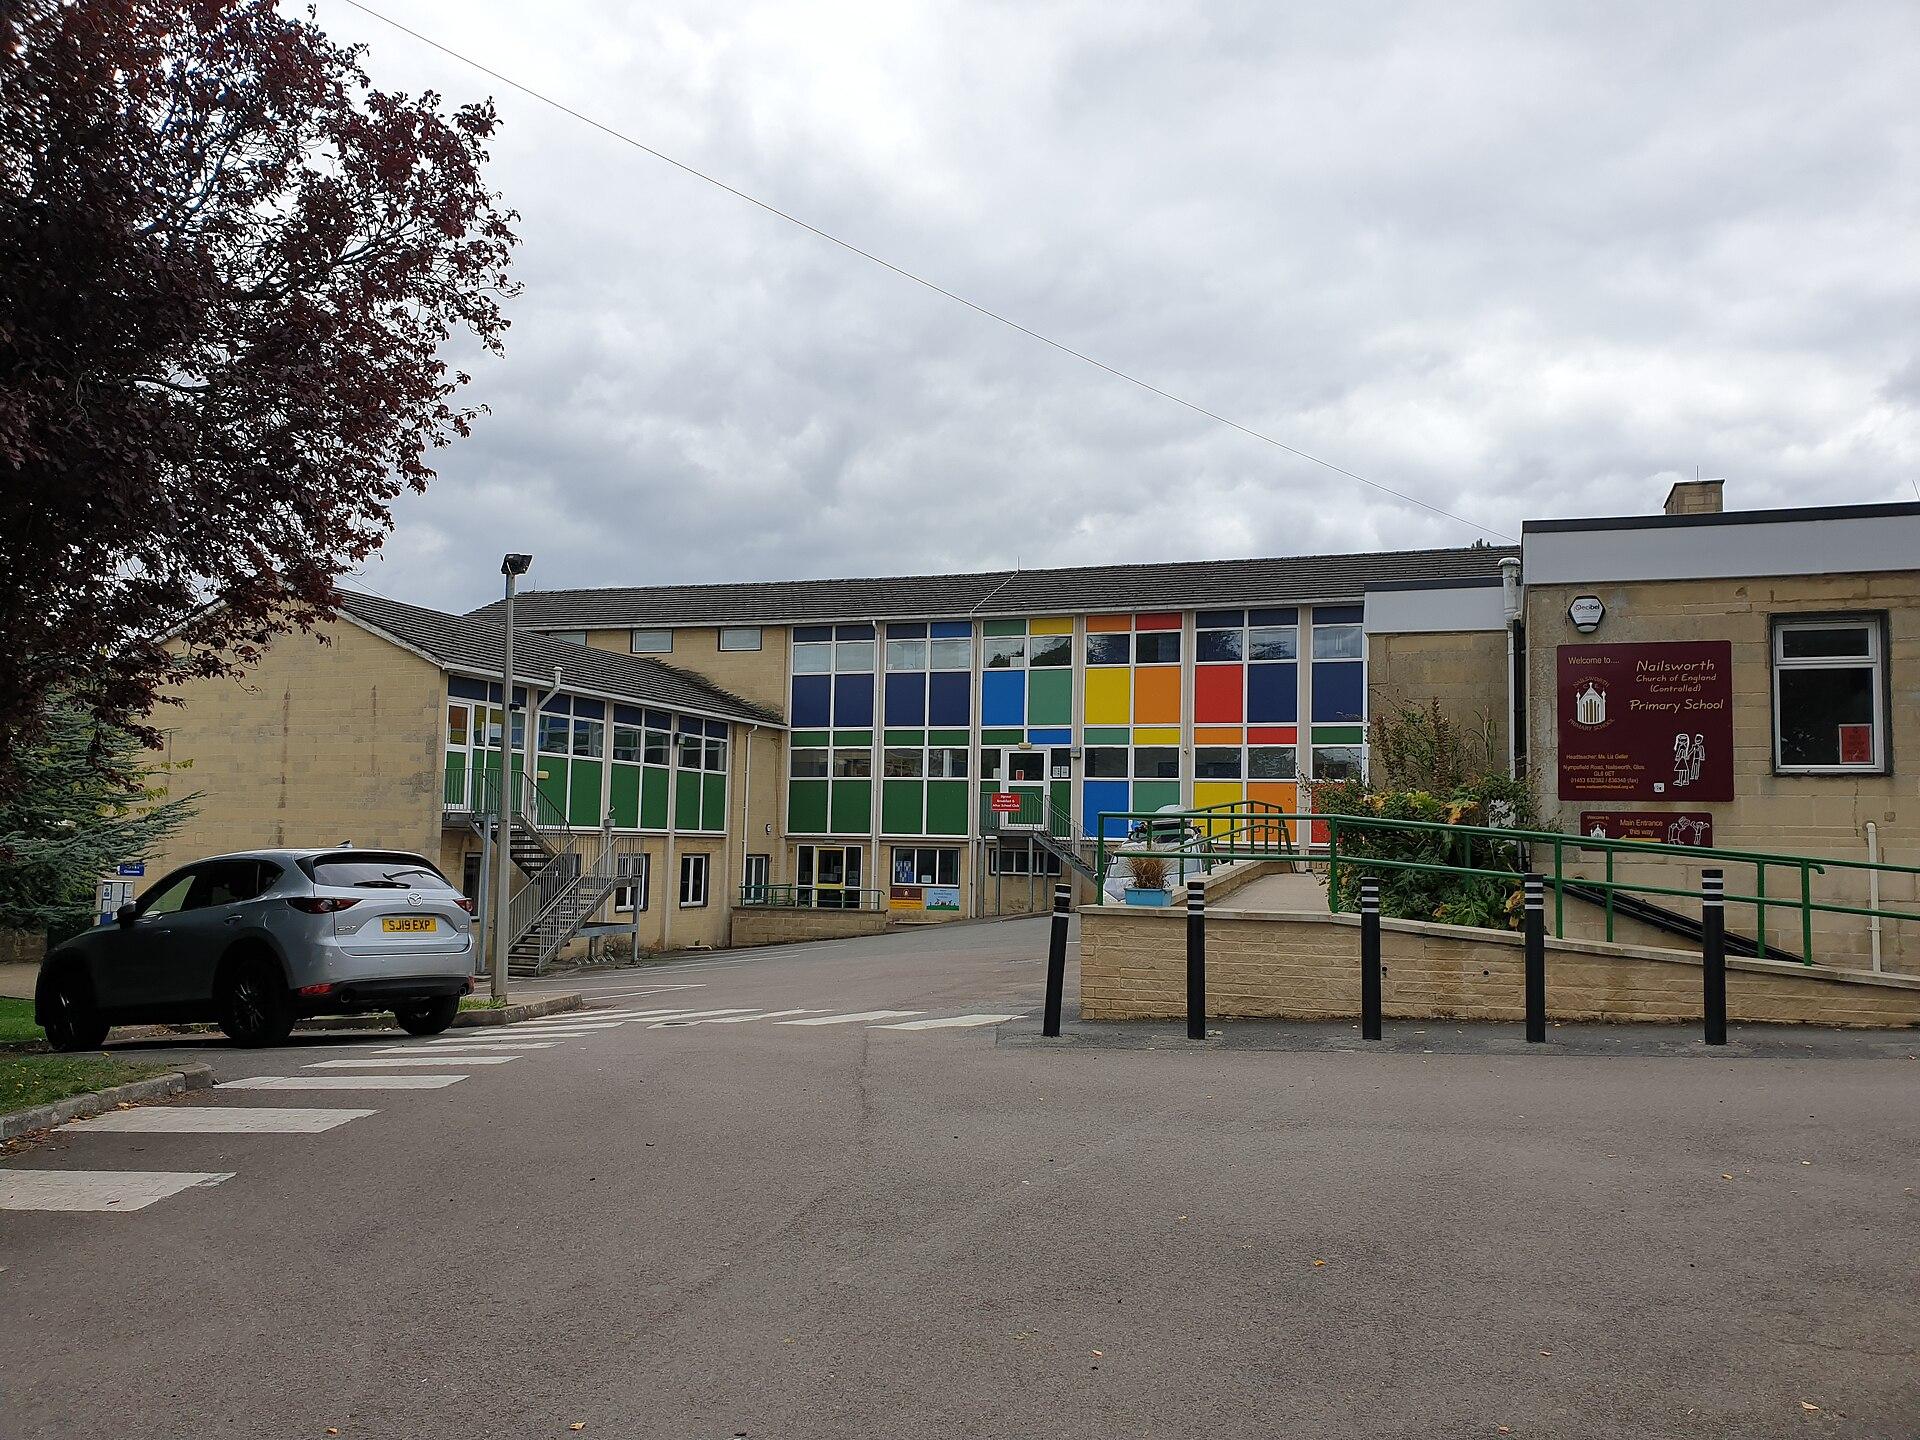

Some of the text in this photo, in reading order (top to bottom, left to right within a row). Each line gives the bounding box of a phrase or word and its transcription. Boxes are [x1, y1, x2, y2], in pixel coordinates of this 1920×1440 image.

[1568, 656, 1602, 665] Welcome
[1636, 659, 1715, 672] Nailsworth
[1636, 673, 1717, 683] Church of England
[1650, 684, 1702, 693] (Controlled)
[1629, 698, 1724, 714] Primary School
[1568, 718, 1592, 731] PRIMARY
[1620, 819, 1664, 827] Main Entrance
[388, 920, 431, 931] SJ19 EXP
